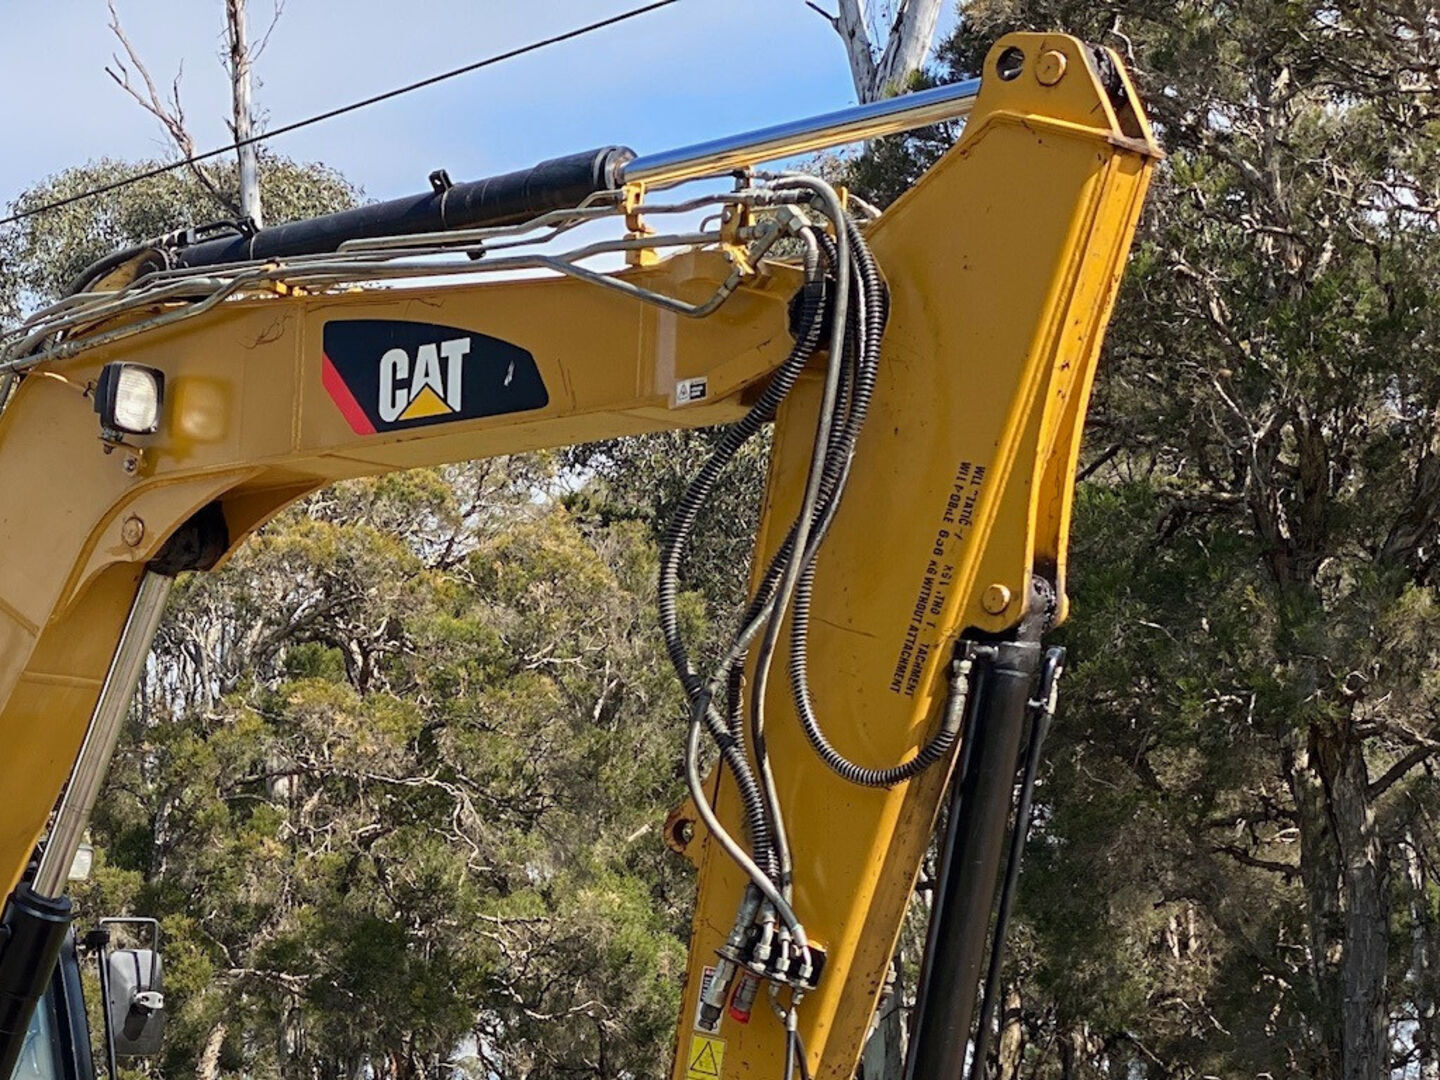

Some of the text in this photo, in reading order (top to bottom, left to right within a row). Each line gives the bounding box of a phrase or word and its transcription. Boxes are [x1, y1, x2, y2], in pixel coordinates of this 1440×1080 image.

[379, 337, 471, 422] CAT
[911, 576, 935, 624] WITHOUT
[889, 623, 919, 694] ATTACHMENT
